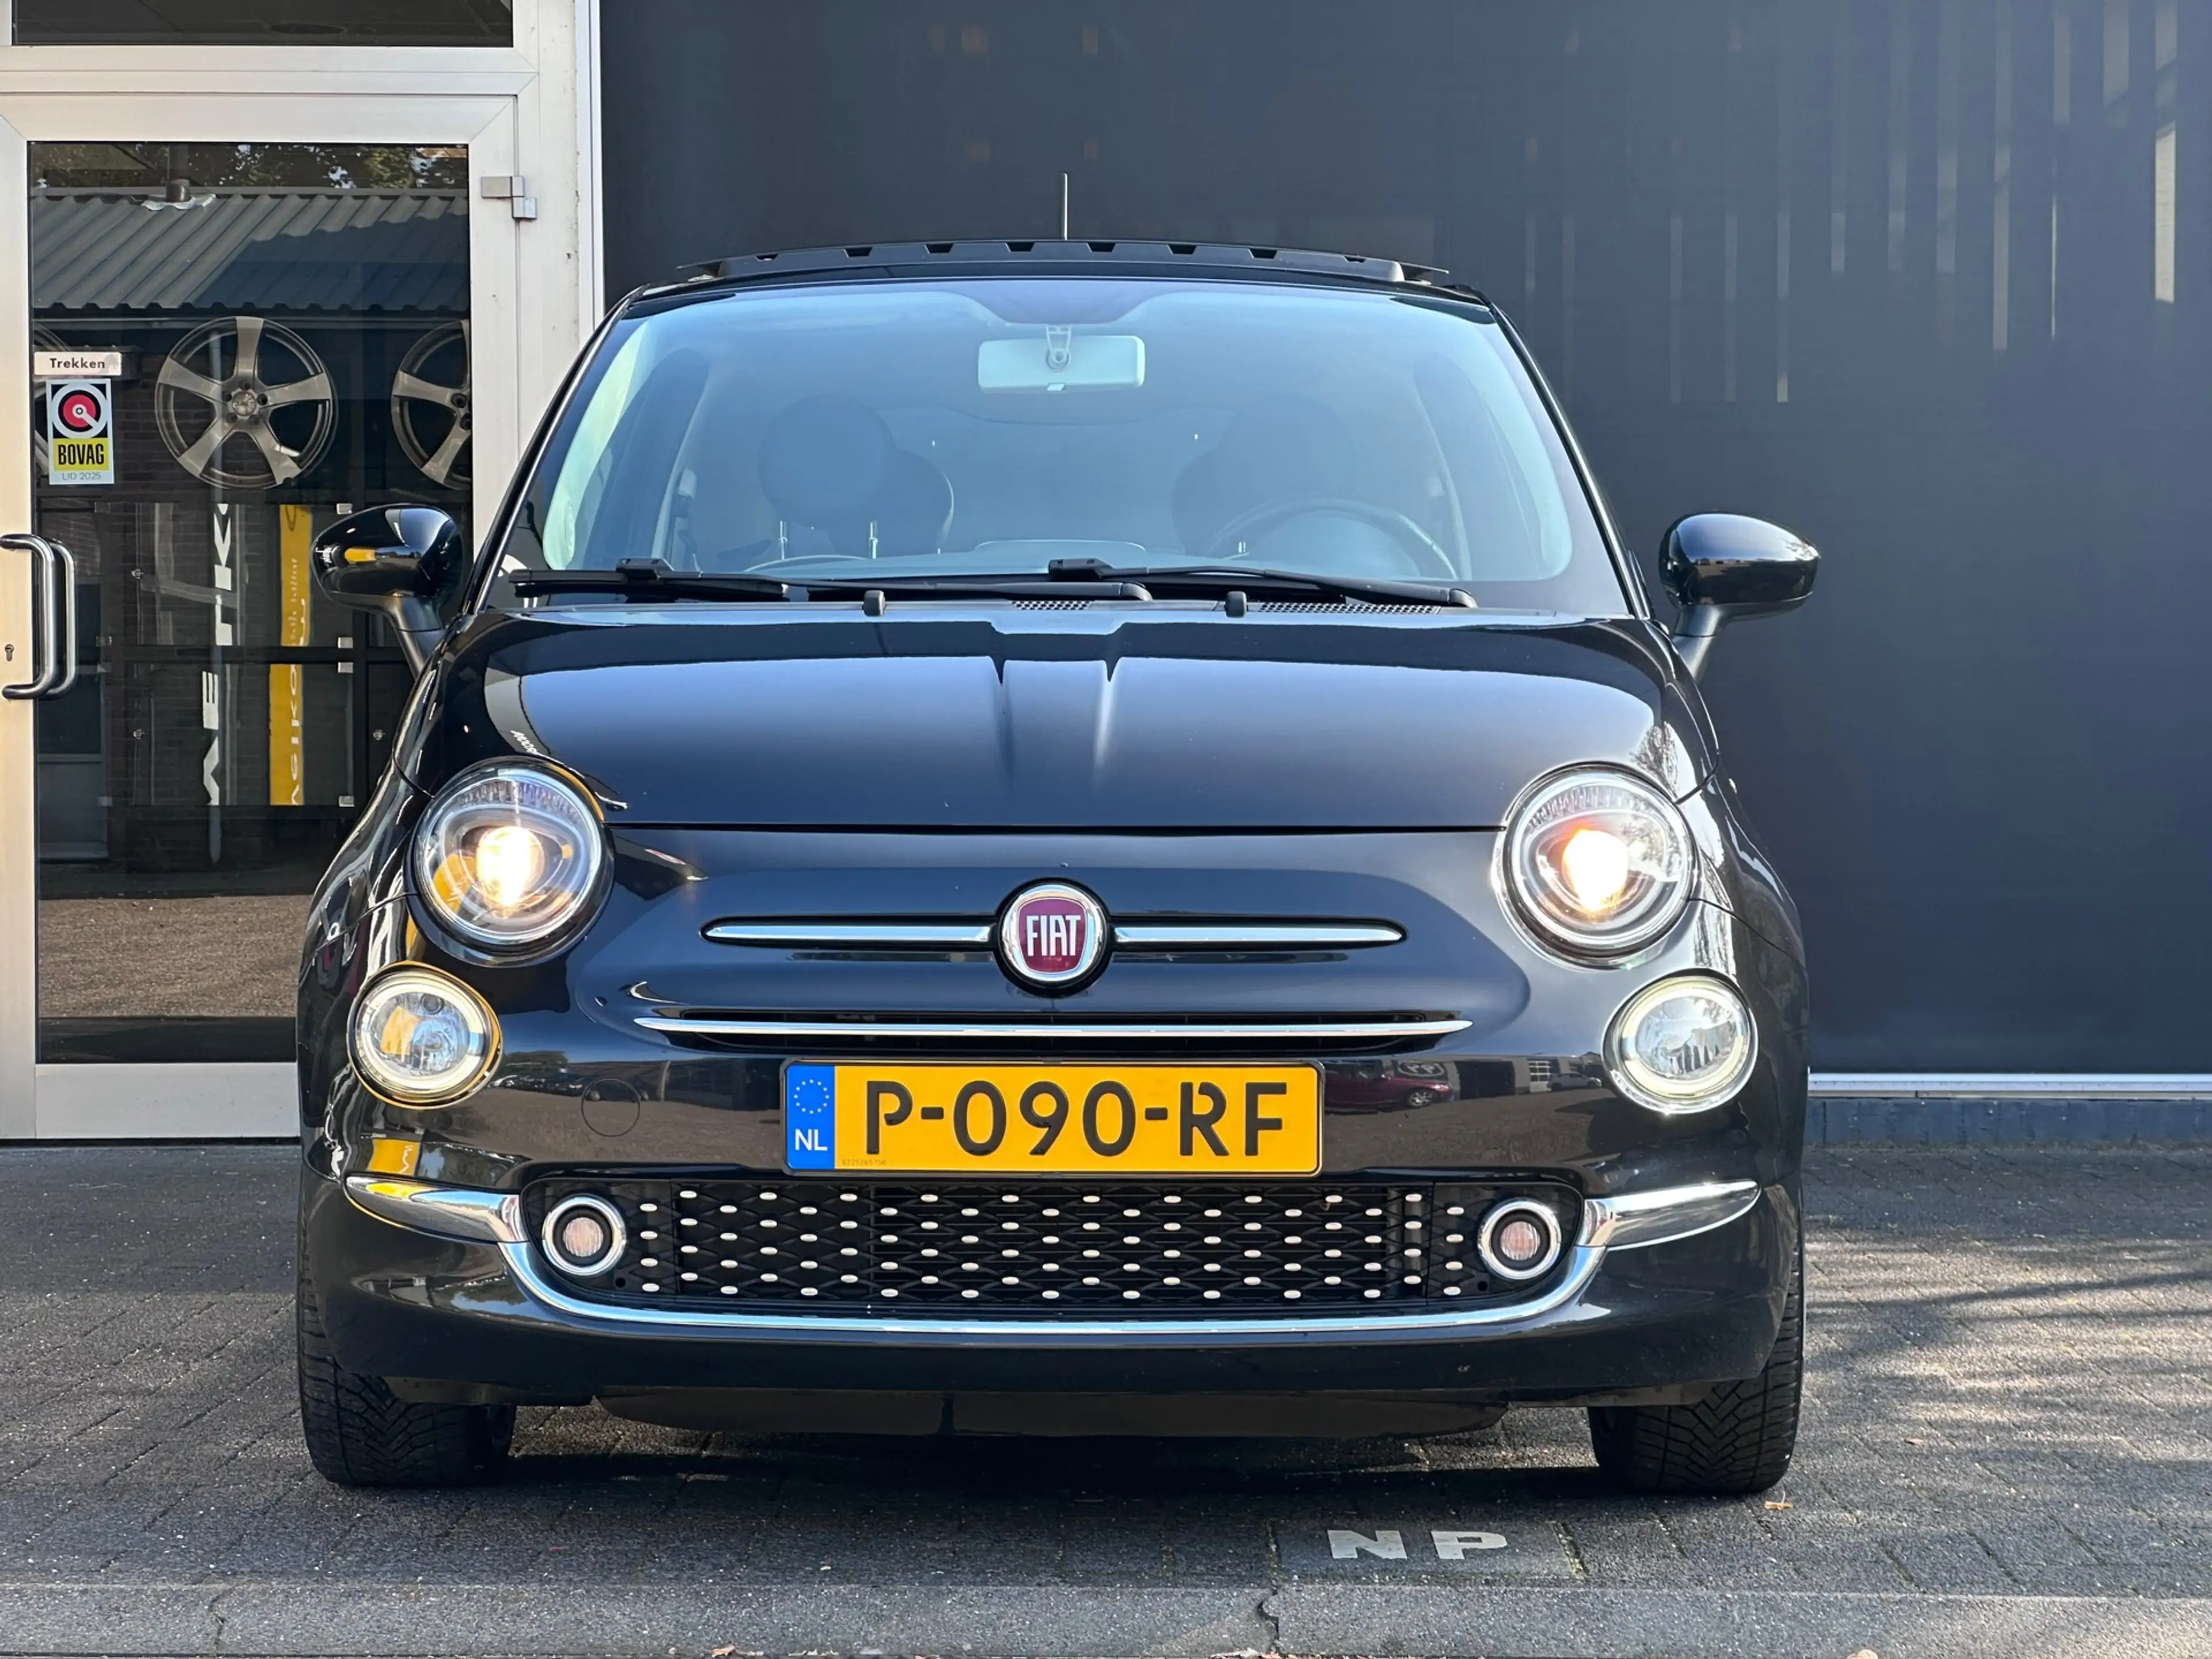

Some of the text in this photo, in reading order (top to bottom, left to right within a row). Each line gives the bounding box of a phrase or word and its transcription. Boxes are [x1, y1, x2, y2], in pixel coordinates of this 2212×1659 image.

[50, 357, 106, 369] Trekken
[58, 444, 104, 465] BOVAG
[1026, 915, 1081, 956] FIAT
[866, 1080, 1288, 1156] P-090-RF
[794, 1128, 828, 1152] NL
